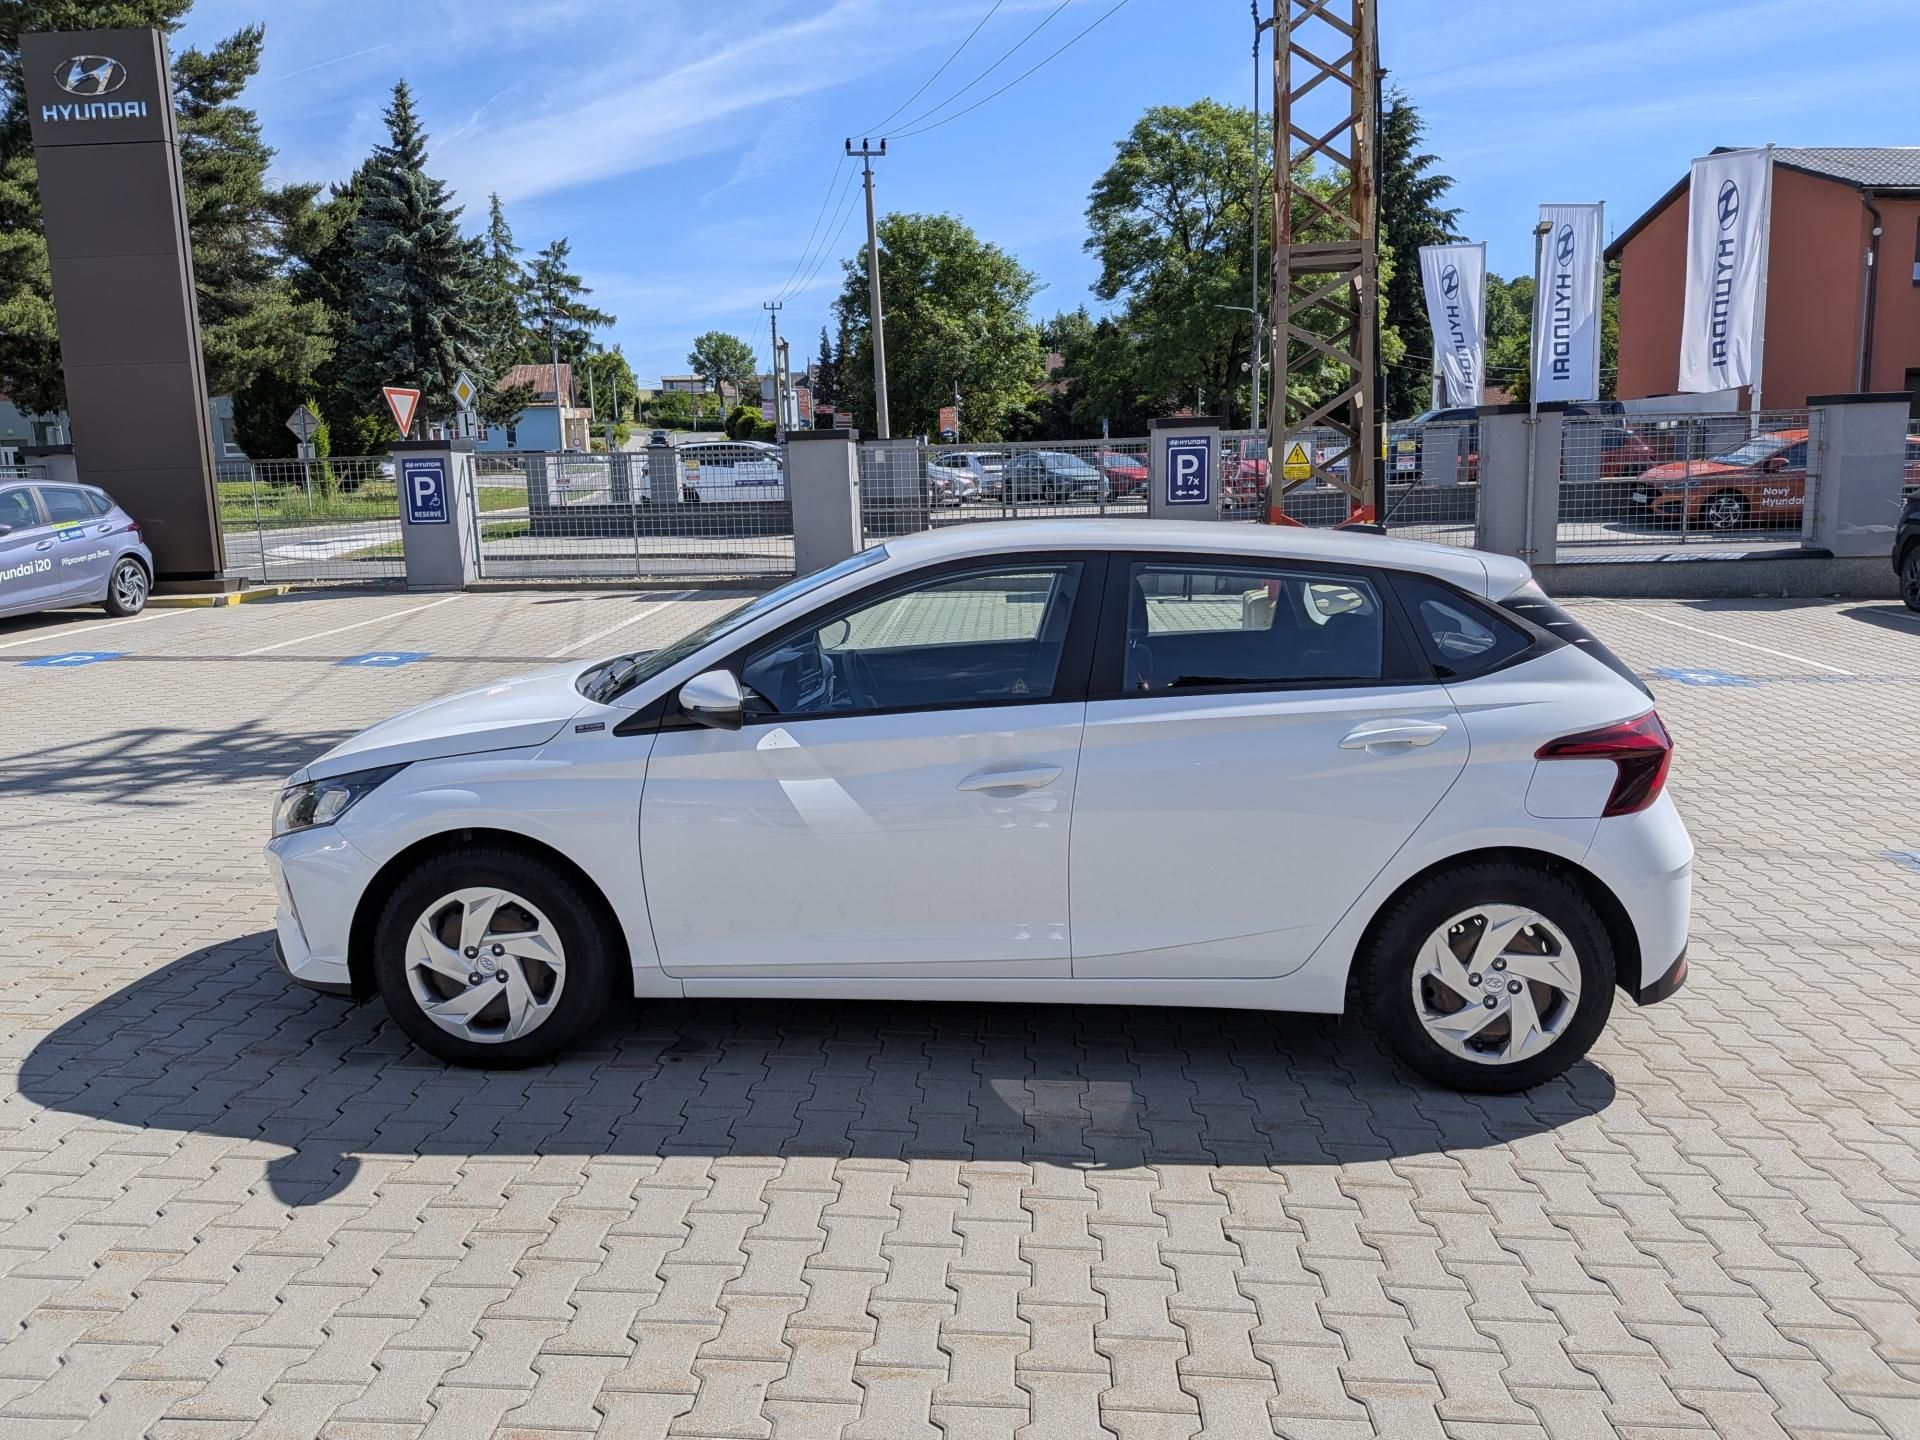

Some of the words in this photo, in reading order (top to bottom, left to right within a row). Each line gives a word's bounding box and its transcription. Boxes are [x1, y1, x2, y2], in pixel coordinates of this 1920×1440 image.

[41, 101, 148, 123] HYUNDAI
[1177, 454, 1199, 486] P
[1187, 476, 1200, 486] 7x
[414, 476, 436, 507] P
[0, 561, 34, 584] yundai
[34, 558, 52, 573] i20
